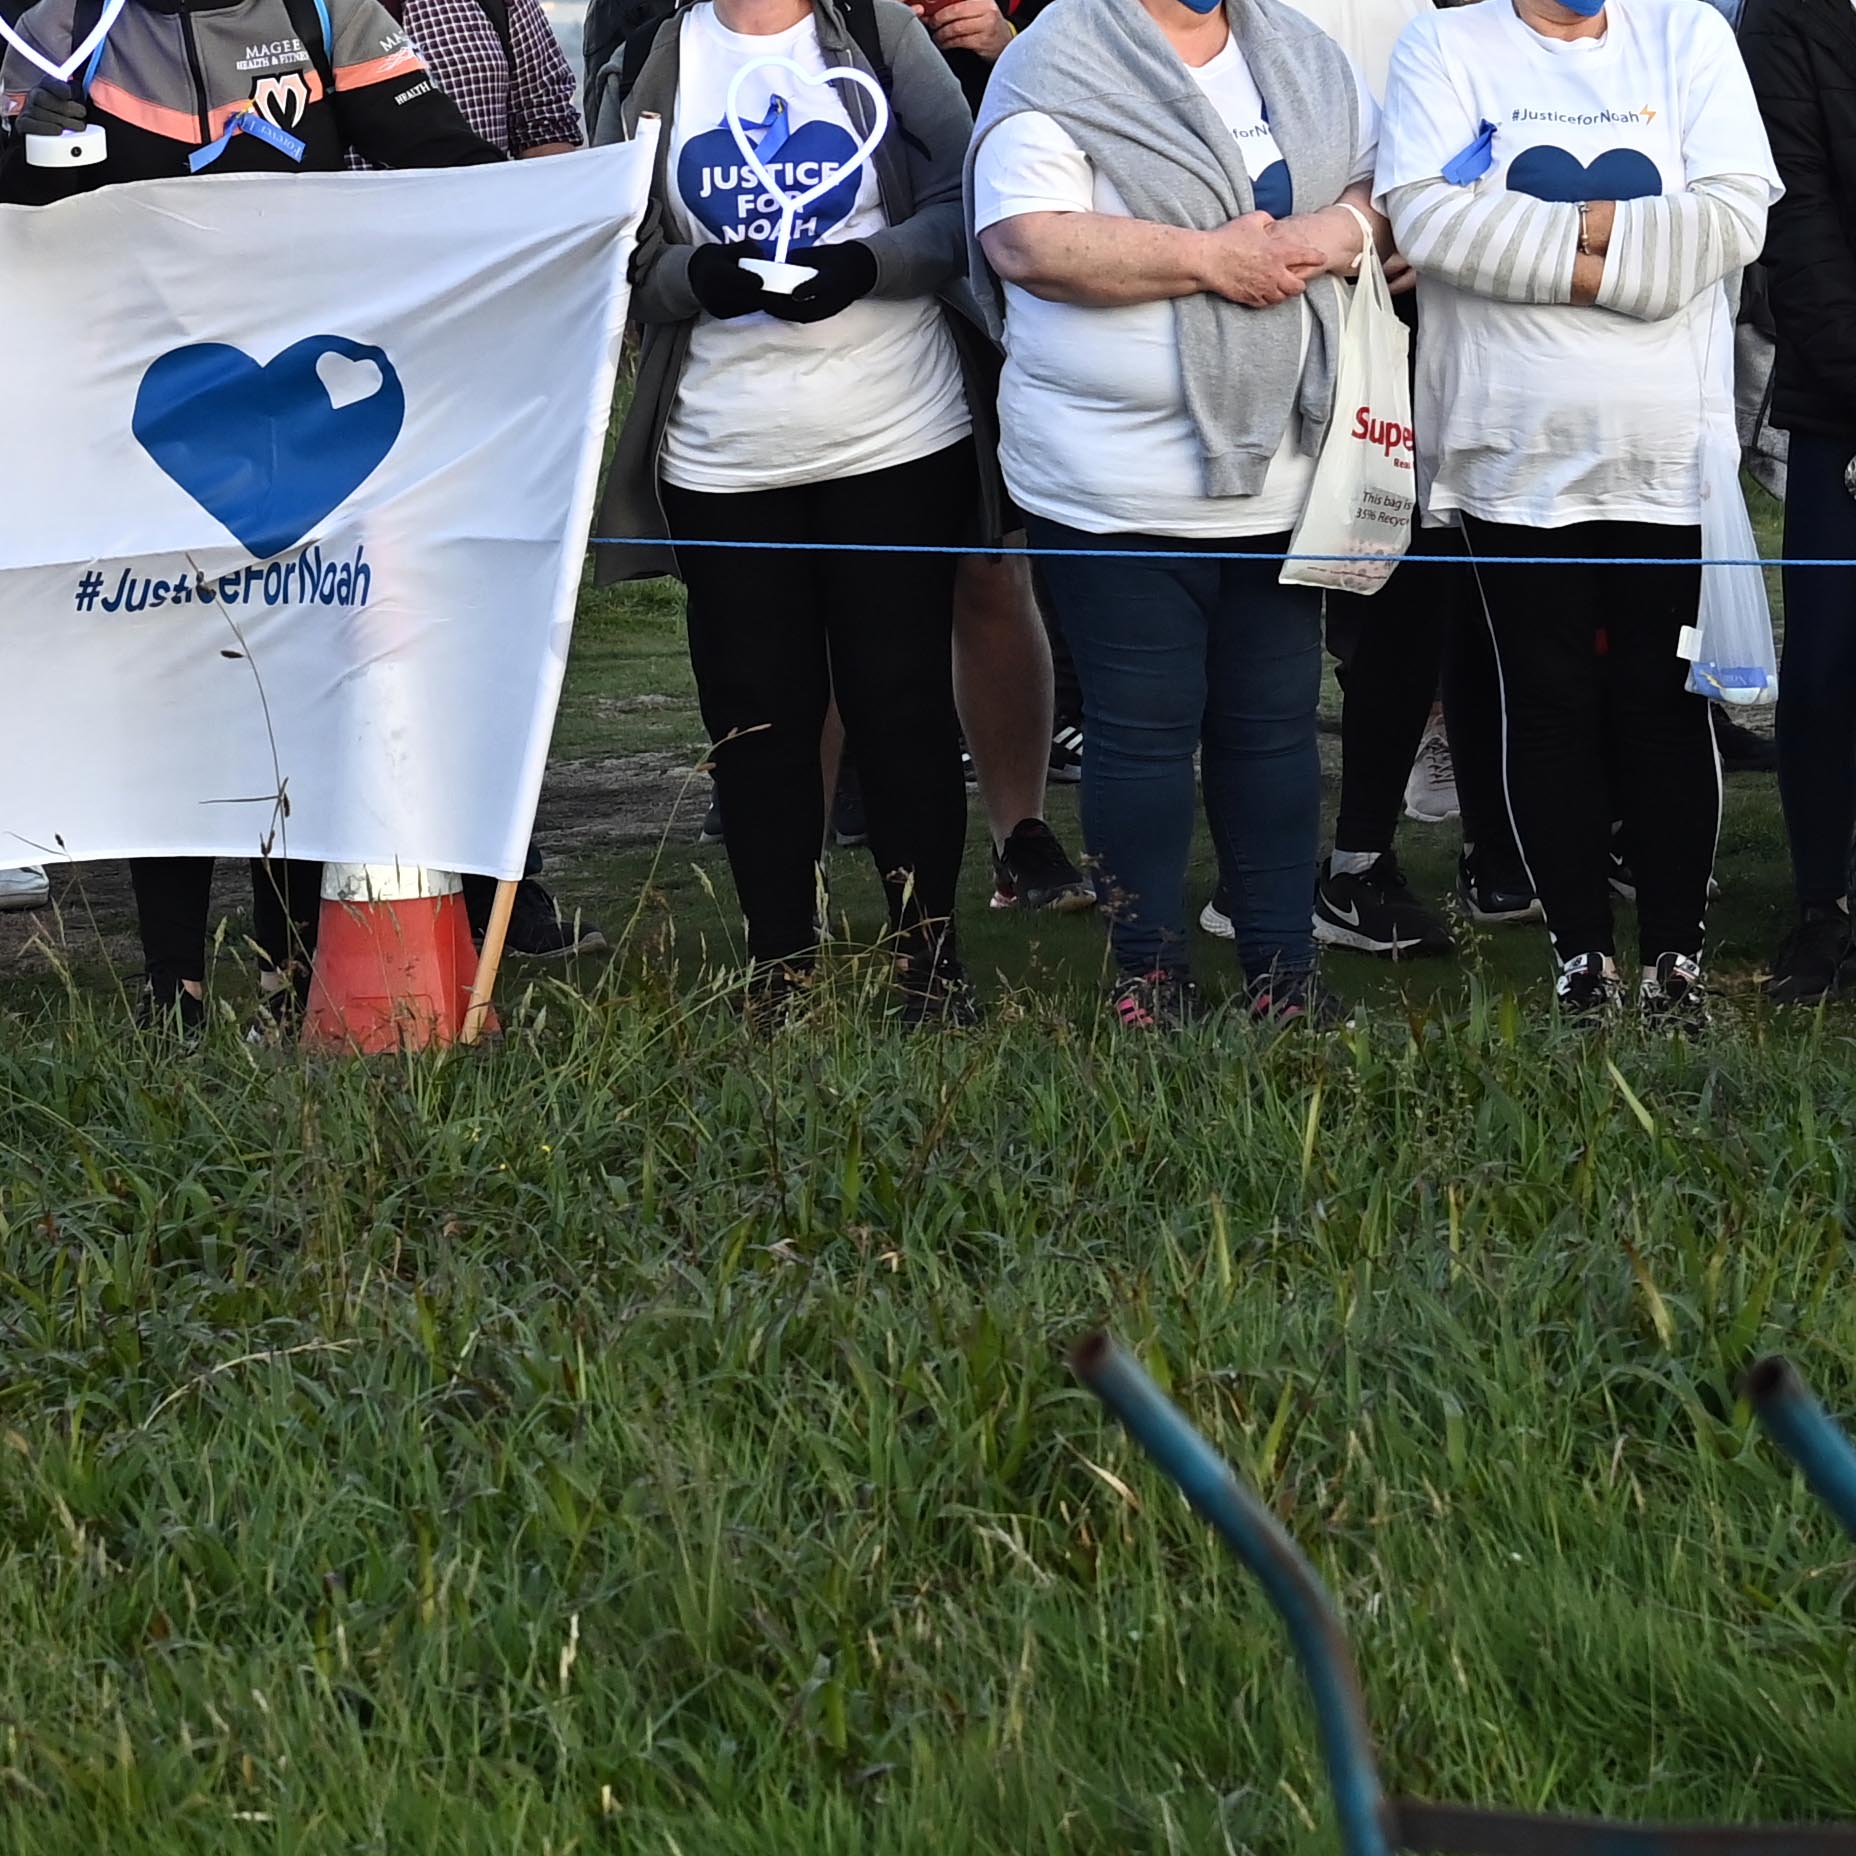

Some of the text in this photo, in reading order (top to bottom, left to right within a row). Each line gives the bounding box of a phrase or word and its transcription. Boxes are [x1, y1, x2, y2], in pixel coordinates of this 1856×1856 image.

[246, 39, 301, 60] MAGEE
[236, 56, 270, 71] HEALTH
[394, 81, 431, 106] HEALTH
[1511, 107, 1640, 126] #JusticeforNoah
[1351, 406, 1414, 457] Supe
[1363, 491, 1383, 505] This
[1384, 496, 1402, 512] bag
[1355, 507, 1376, 521] 35%
